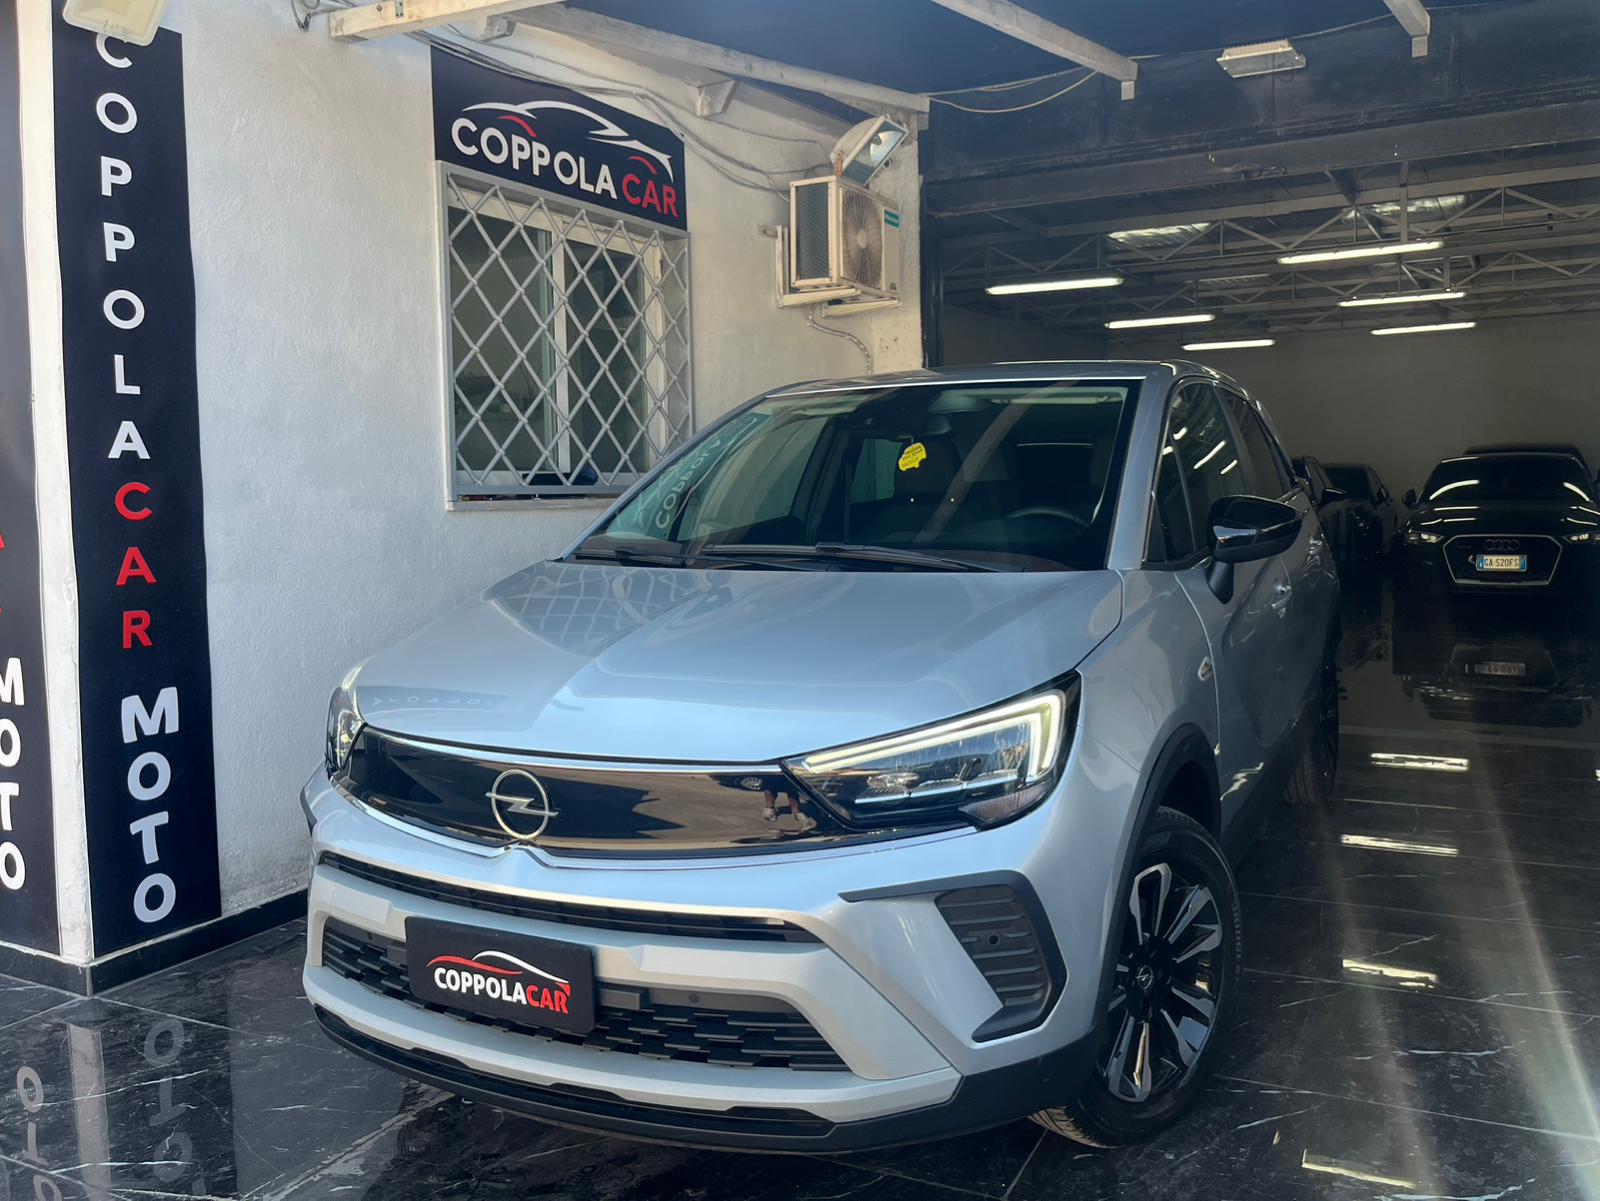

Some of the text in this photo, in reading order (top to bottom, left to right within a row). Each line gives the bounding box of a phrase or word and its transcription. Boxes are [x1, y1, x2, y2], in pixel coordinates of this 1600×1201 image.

[451, 117, 679, 218] COPPOLA CAR
[121, 686, 180, 923] MOTO
